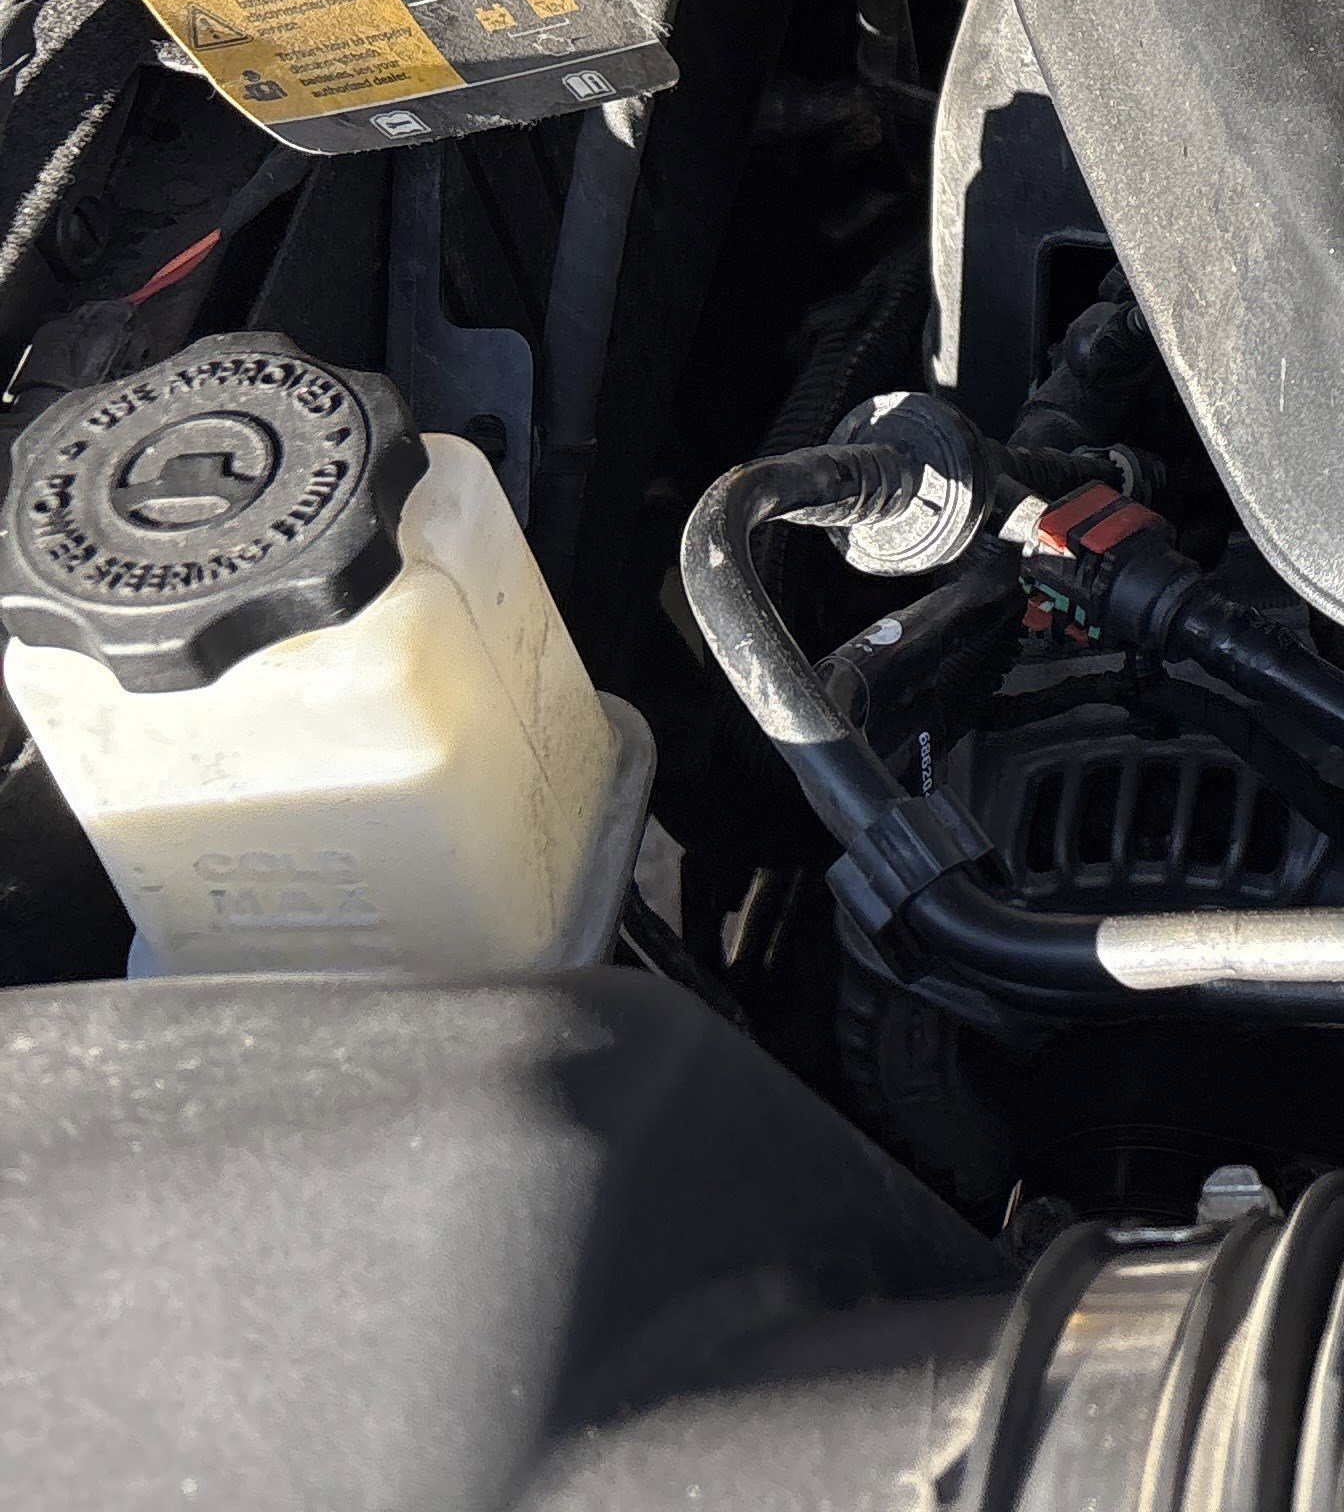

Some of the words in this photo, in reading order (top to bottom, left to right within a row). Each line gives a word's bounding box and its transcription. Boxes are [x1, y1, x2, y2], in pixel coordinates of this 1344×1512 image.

[311, 80, 373, 97] authorized
[372, 72, 411, 85] dealer.
[374, 60, 403, 72] your
[83, 383, 158, 432] USE
[168, 358, 346, 418] APPROVED
[30, 473, 98, 573] POWER
[86, 537, 272, 595] STEERING
[270, 460, 349, 542] FLUID
